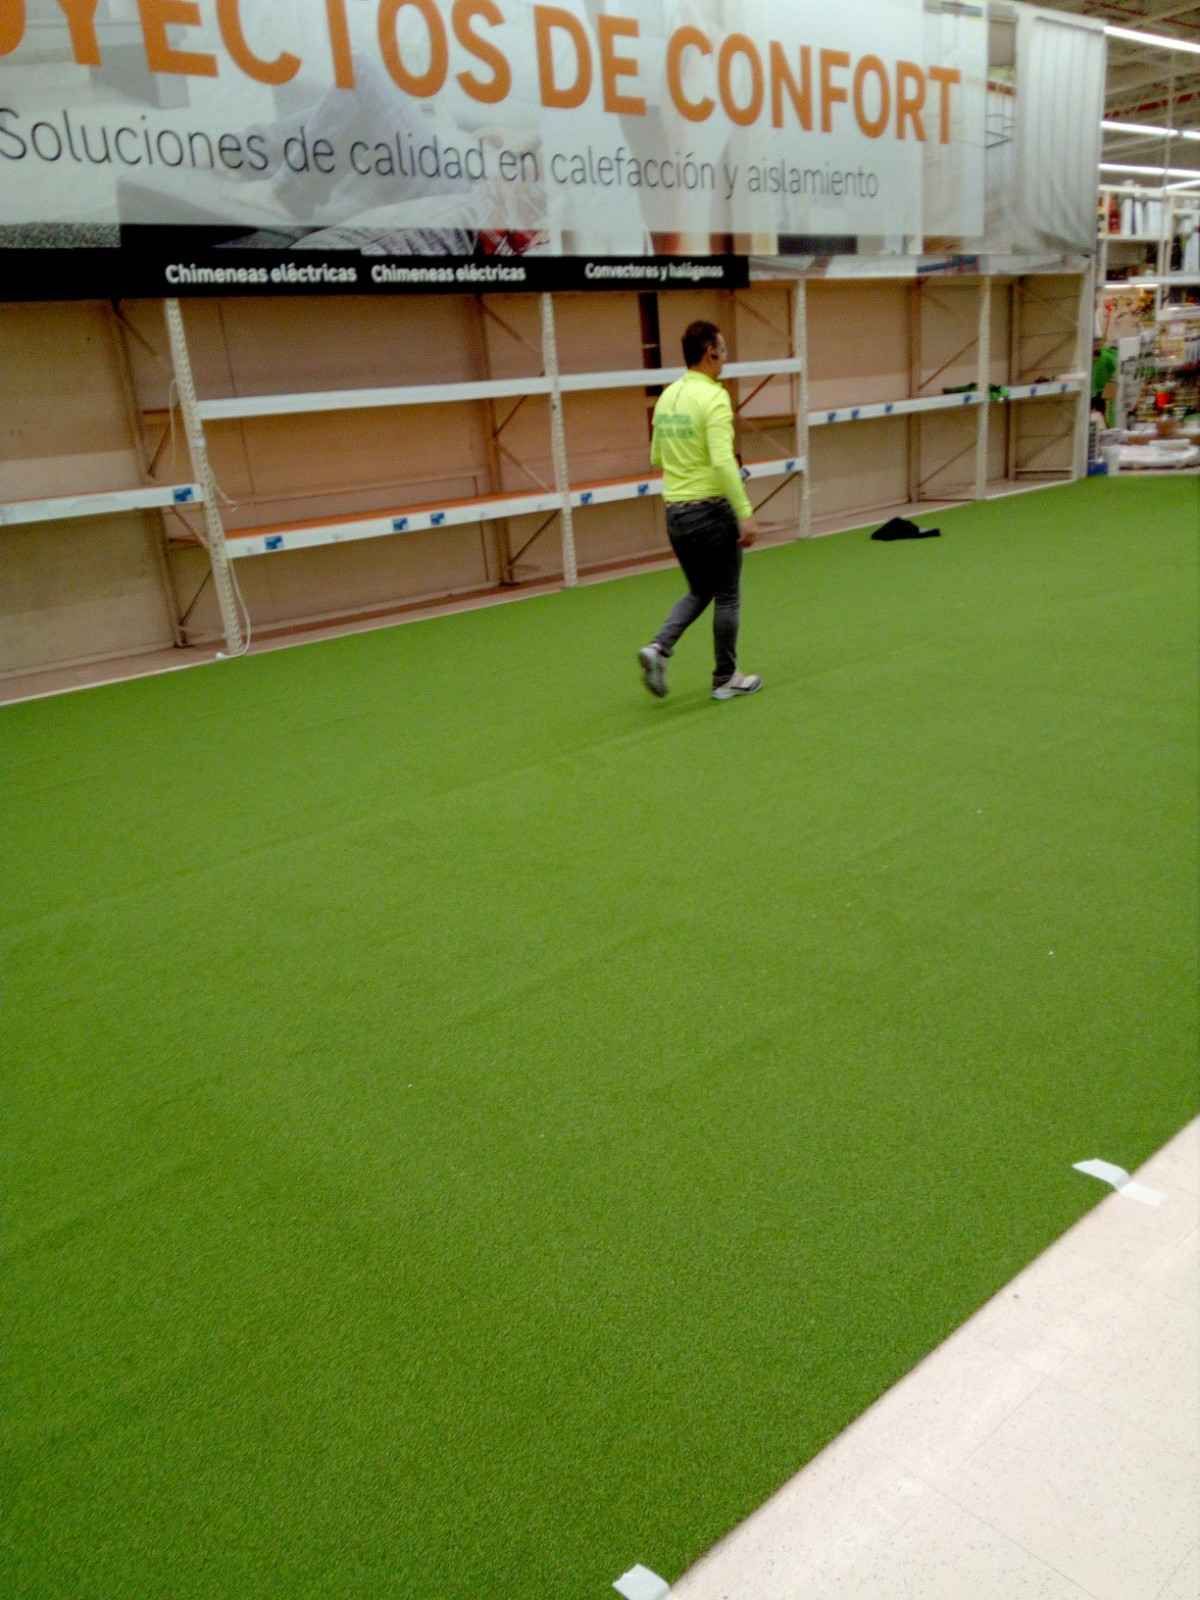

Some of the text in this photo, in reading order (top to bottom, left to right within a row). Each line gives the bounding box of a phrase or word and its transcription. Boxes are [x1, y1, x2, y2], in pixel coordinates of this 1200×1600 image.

[533, 5, 646, 116] DE
[666, 26, 960, 144] CONFORT
[0, 107, 879, 200] Soluciones de calidad en calefacción y aislamiento
[165, 263, 357, 284] Chimeneas eléctricas
[371, 264, 526, 283] Chimeneas eléctricas
[585, 262, 724, 281] Convectores y halógenos
